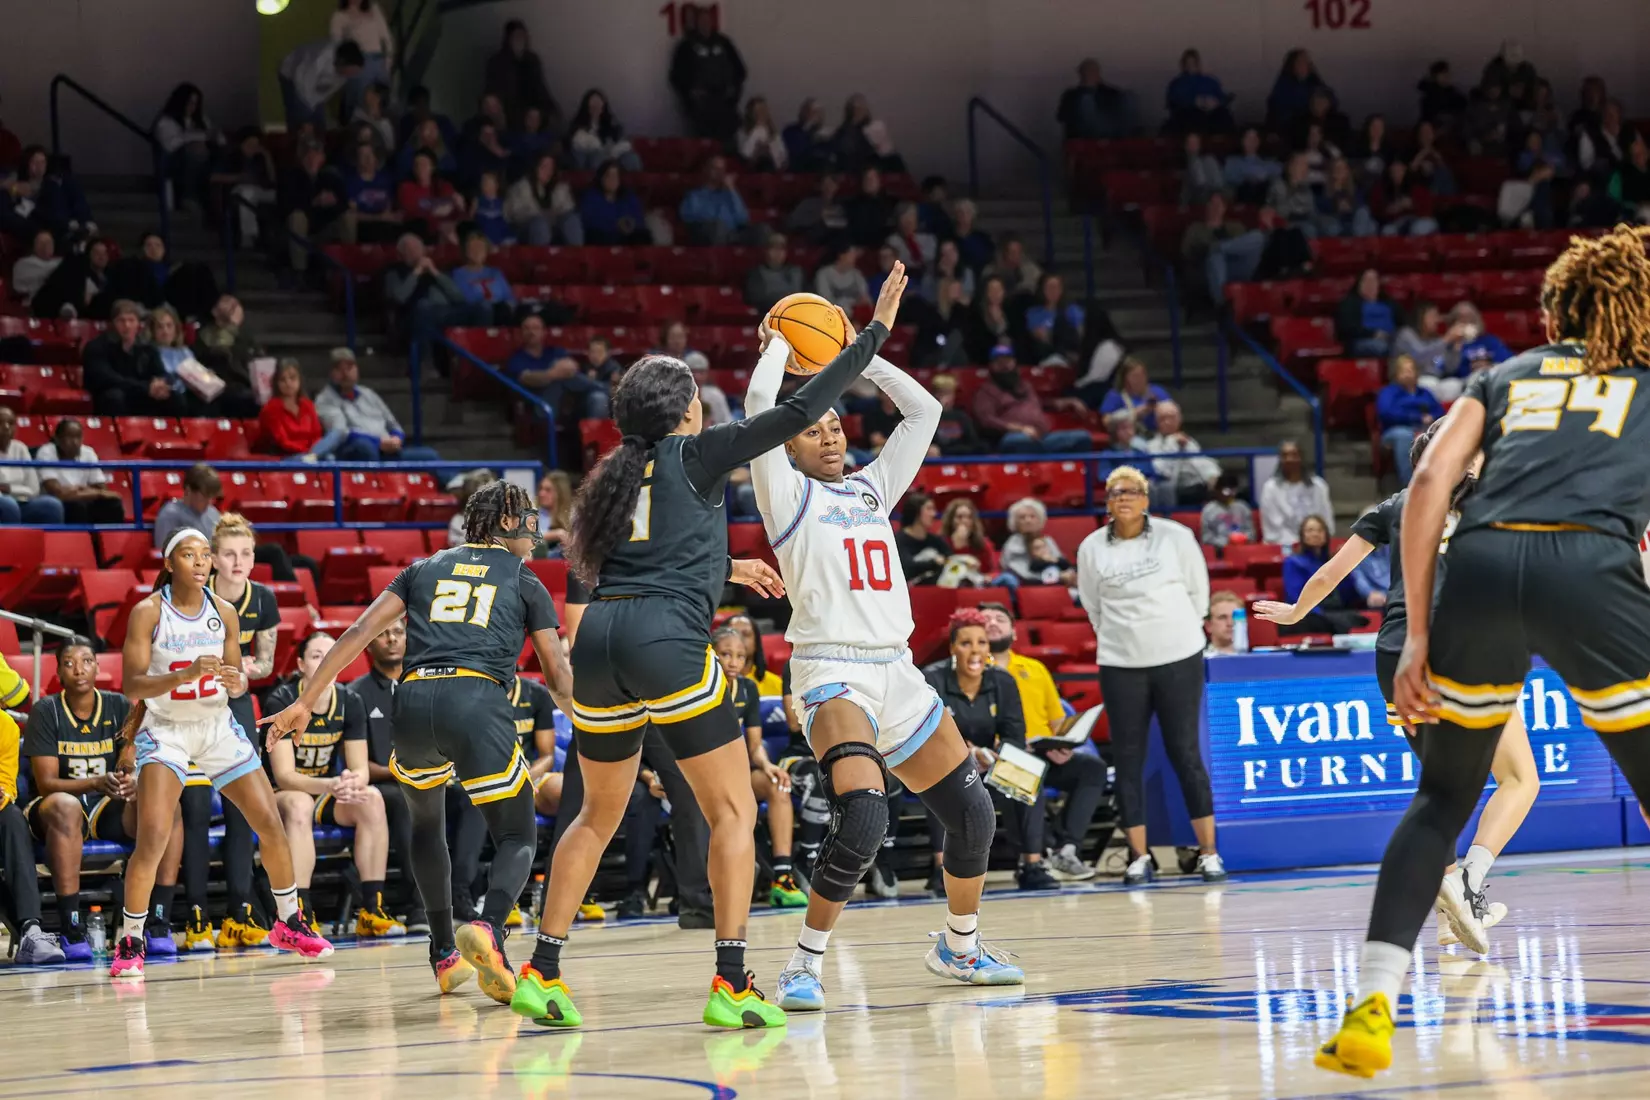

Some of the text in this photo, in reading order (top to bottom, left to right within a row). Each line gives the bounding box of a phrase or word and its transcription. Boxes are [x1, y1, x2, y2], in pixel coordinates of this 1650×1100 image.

[1303, 0, 1371, 29] 102
[1500, 375, 1638, 439] 24
[452, 563, 491, 578] BERRY
[843, 538, 893, 591] 10
[429, 580, 498, 629] 21
[1236, 697, 1374, 746] Ivan
[58, 738, 114, 756] KENNESAW
[296, 745, 335, 767] 45
[68, 758, 106, 779] 33
